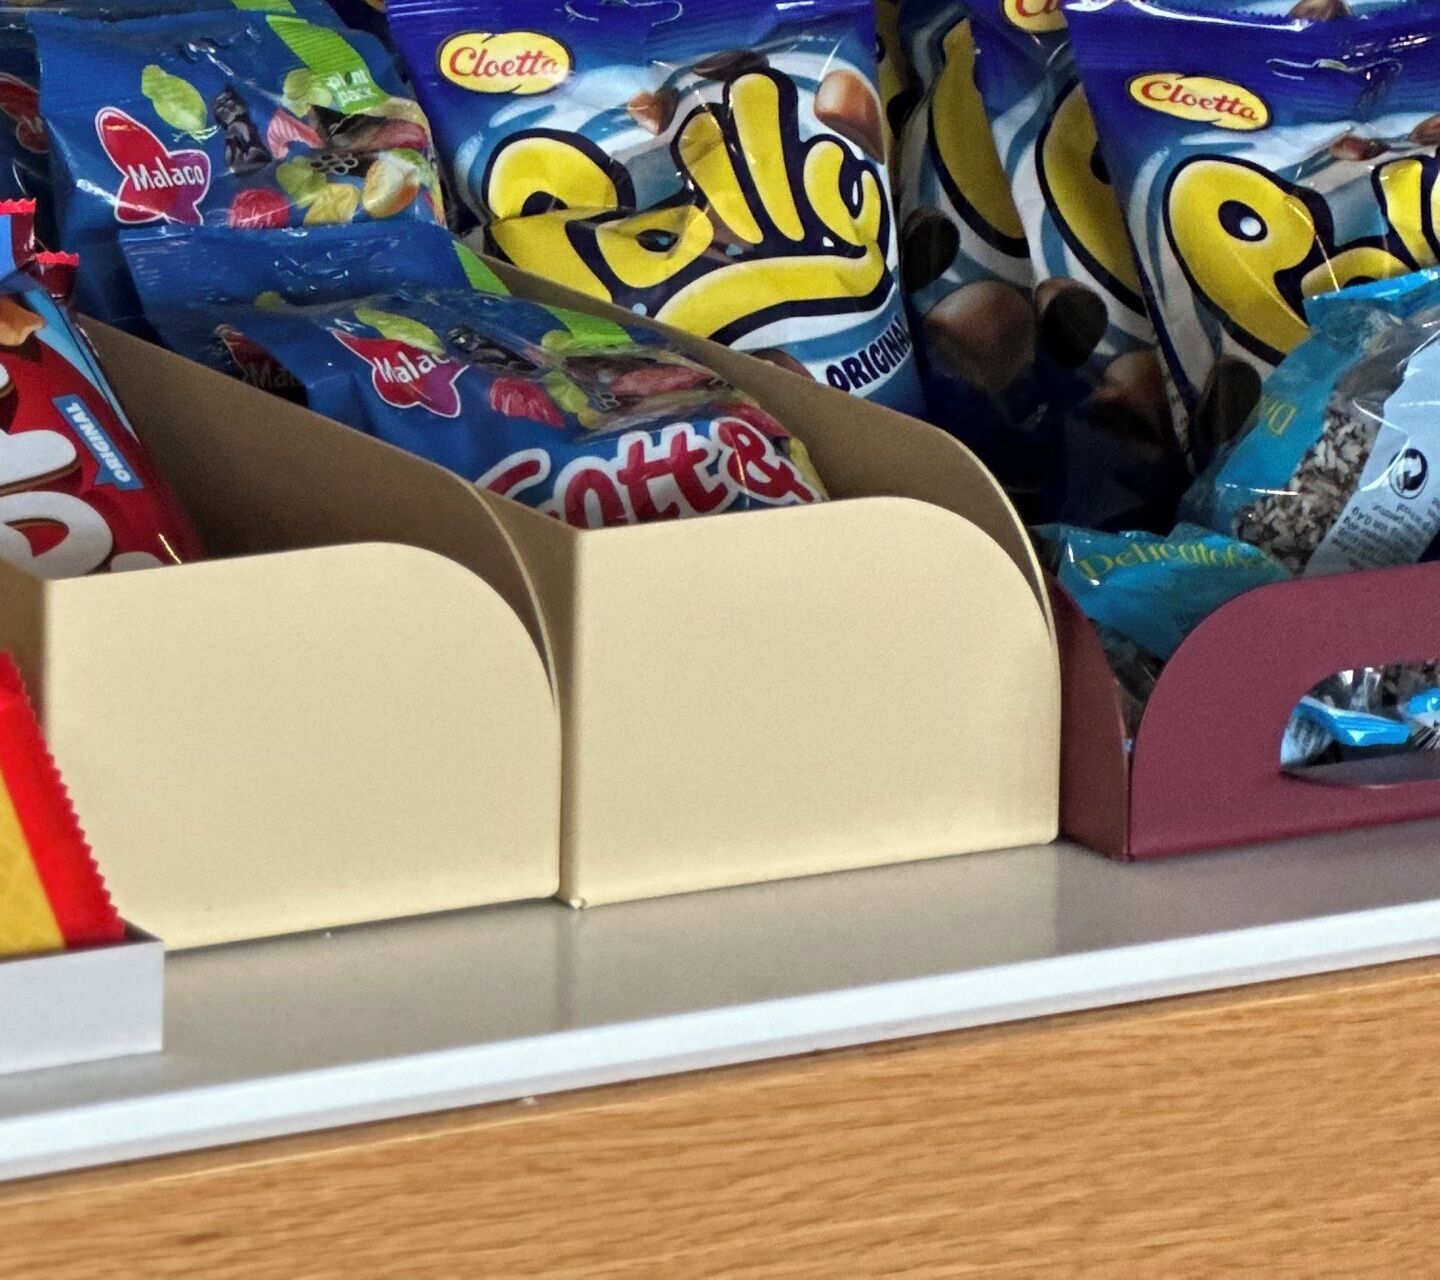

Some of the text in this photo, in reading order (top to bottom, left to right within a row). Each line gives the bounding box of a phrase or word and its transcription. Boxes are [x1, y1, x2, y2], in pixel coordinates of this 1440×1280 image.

[448, 45, 564, 81] Cloetta
[1140, 79, 1259, 123] Cloetta
[129, 159, 205, 192] Malaco
[486, 72, 885, 342] Polly
[63, 396, 133, 486] ORIGINAL
[489, 422, 812, 529] ott &
